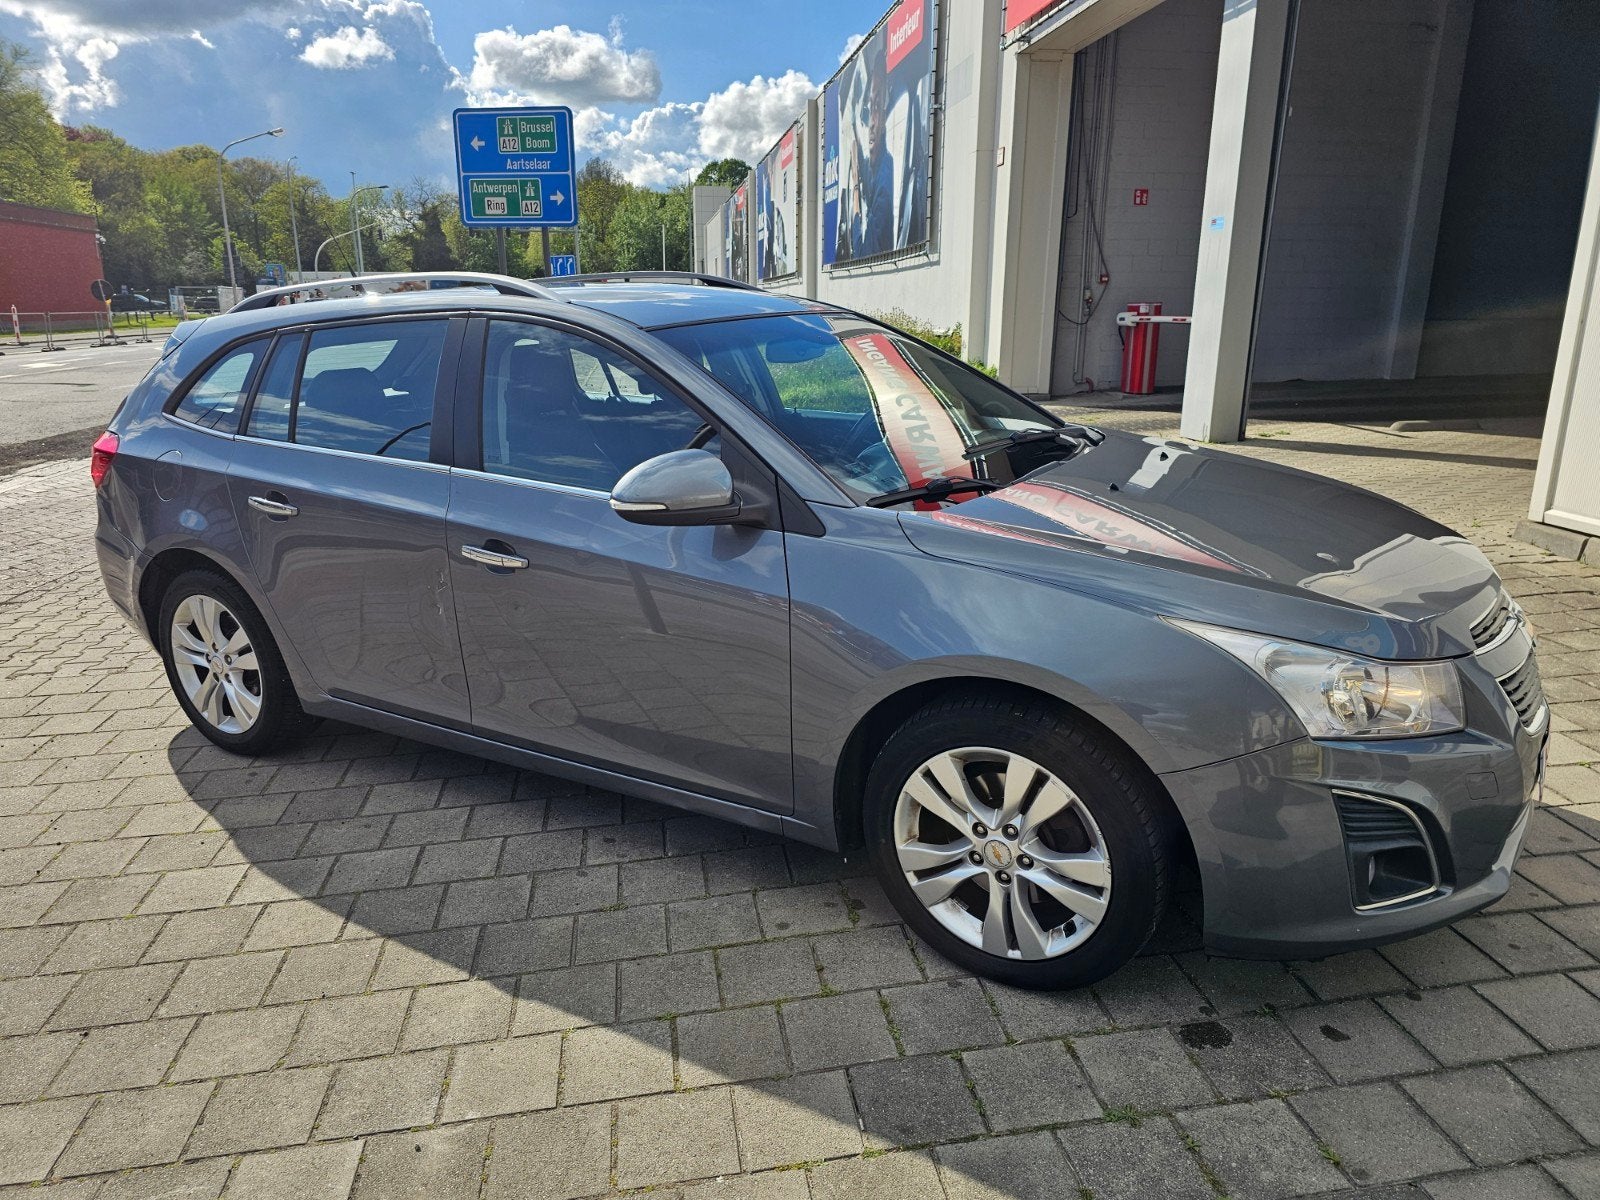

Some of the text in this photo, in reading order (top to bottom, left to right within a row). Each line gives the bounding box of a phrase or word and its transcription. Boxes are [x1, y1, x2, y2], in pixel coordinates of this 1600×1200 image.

[890, 7, 920, 54] Interieur
[520, 121, 554, 134] Brussel
[501, 138, 518, 150] A12
[526, 137, 550, 149] Boom
[506, 158, 551, 170] Aartselaar
[472, 182, 518, 195] Antwerpen
[487, 200, 506, 214] Ring
[524, 202, 539, 213] A12
